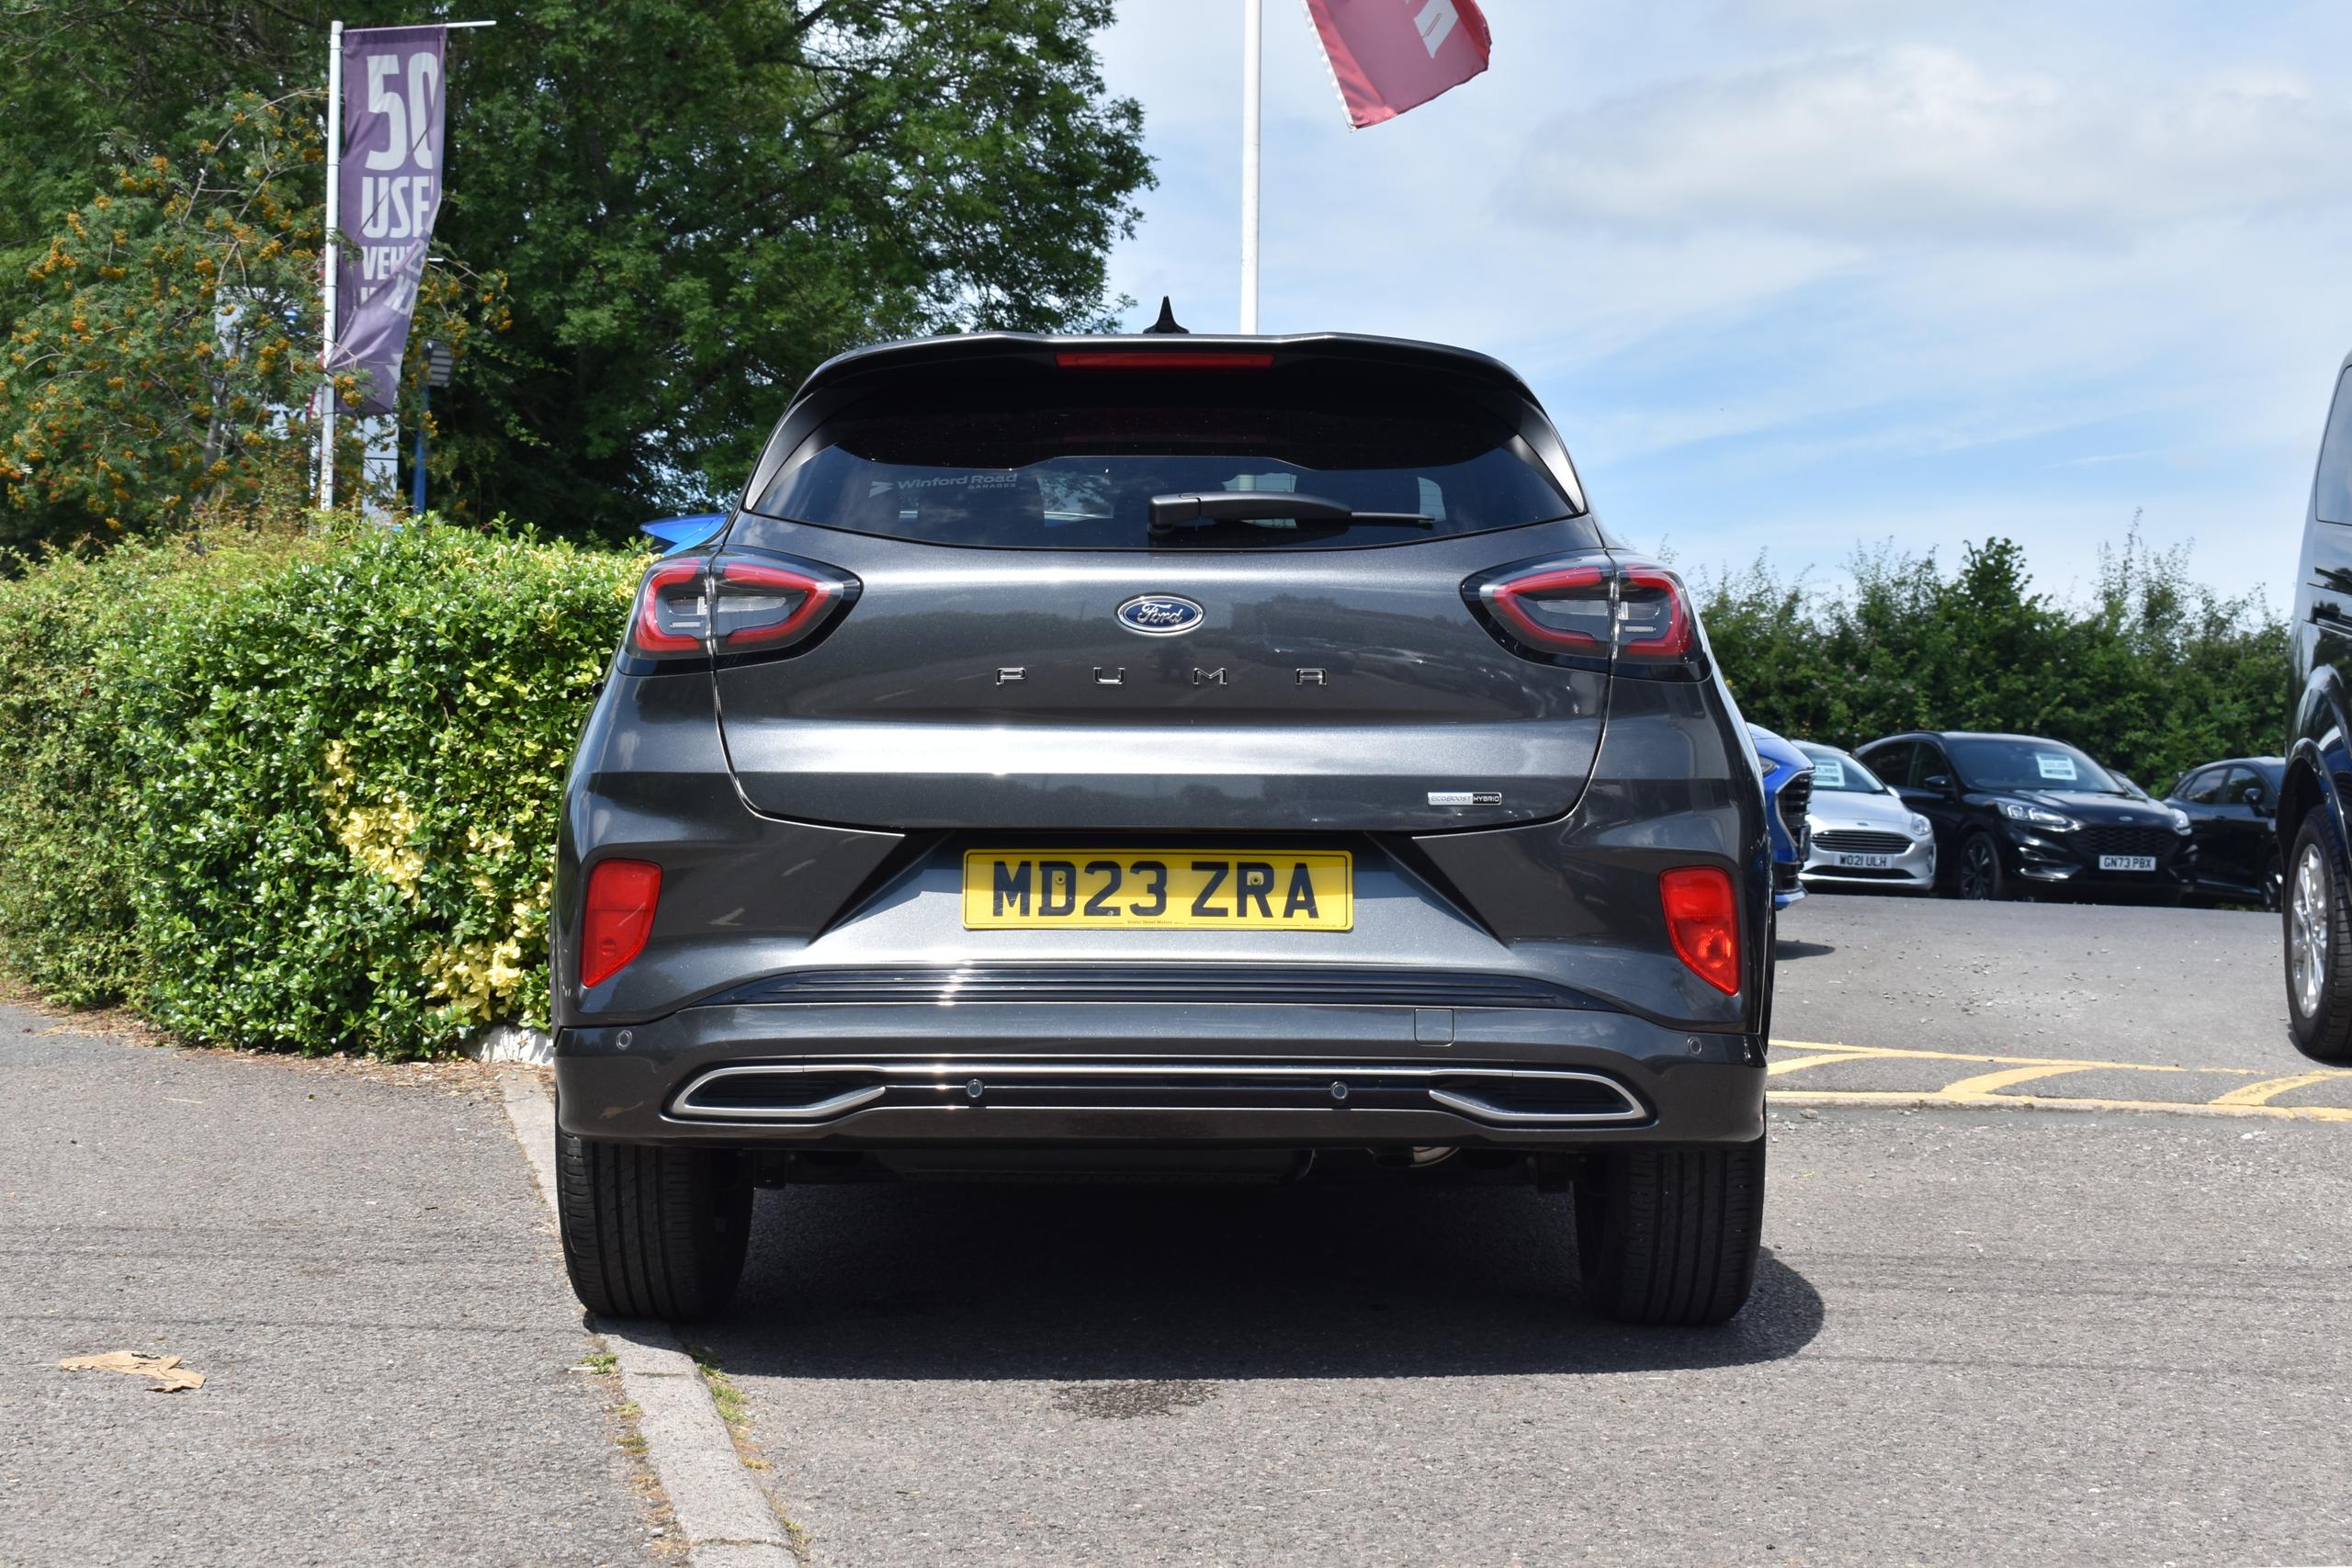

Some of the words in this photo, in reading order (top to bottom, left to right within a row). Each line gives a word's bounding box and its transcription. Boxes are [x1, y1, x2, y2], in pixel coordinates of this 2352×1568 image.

[898, 475, 967, 489] Winford
[971, 473, 1018, 484] Road
[1136, 603, 1183, 624] Ford
[996, 666, 1328, 685] PUMA
[1866, 856, 1887, 867] ULH
[2103, 856, 2131, 868] GN73
[2132, 858, 2153, 869] PBX
[992, 860, 1168, 917] MD23
[1191, 863, 1320, 919] ZRA
